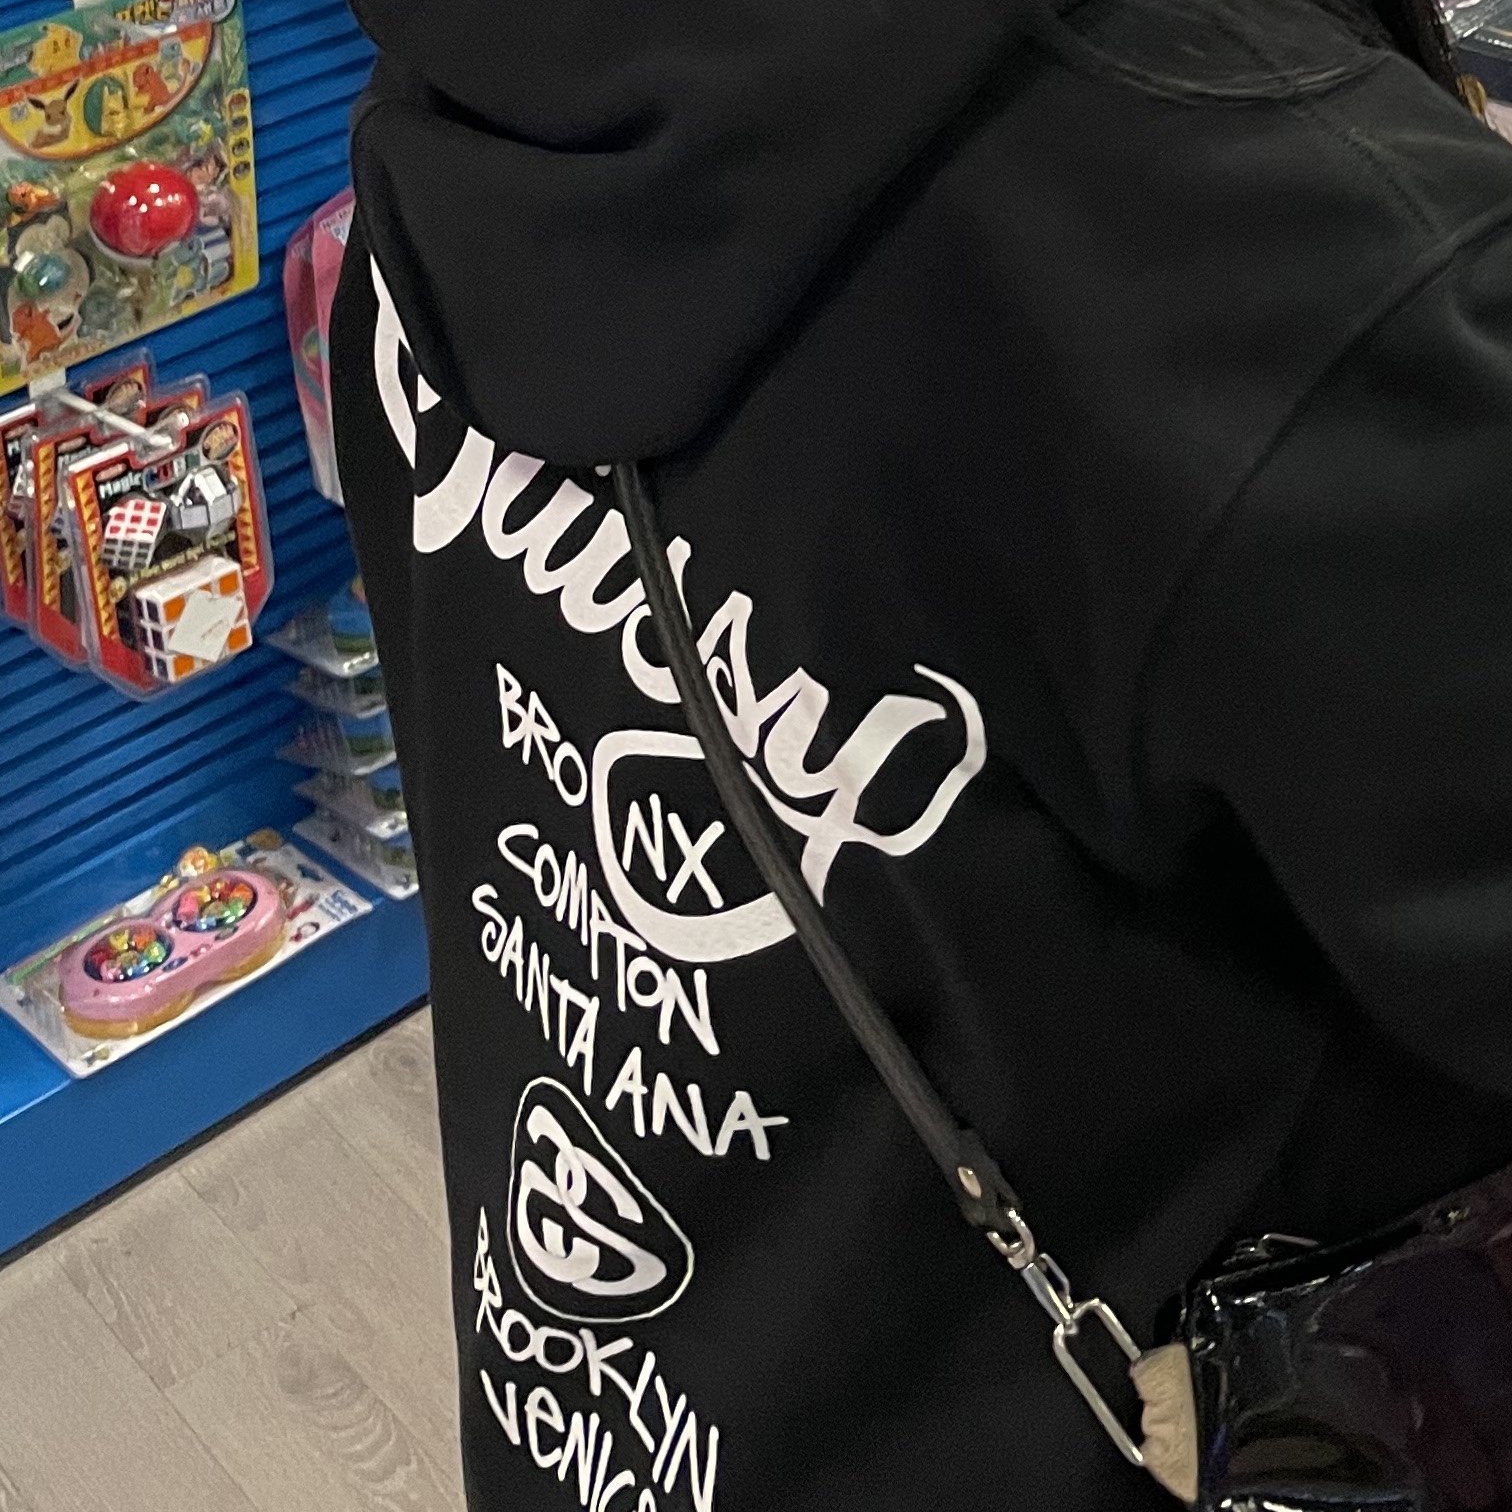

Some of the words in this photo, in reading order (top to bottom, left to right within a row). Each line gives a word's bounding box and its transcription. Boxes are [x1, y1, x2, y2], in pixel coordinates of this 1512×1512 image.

[622, 792, 726, 910] NX
[472, 884, 600, 1096] SANTA
[604, 1046, 790, 1162] ANA
[473, 1205, 720, 1512] BROOKLYN
